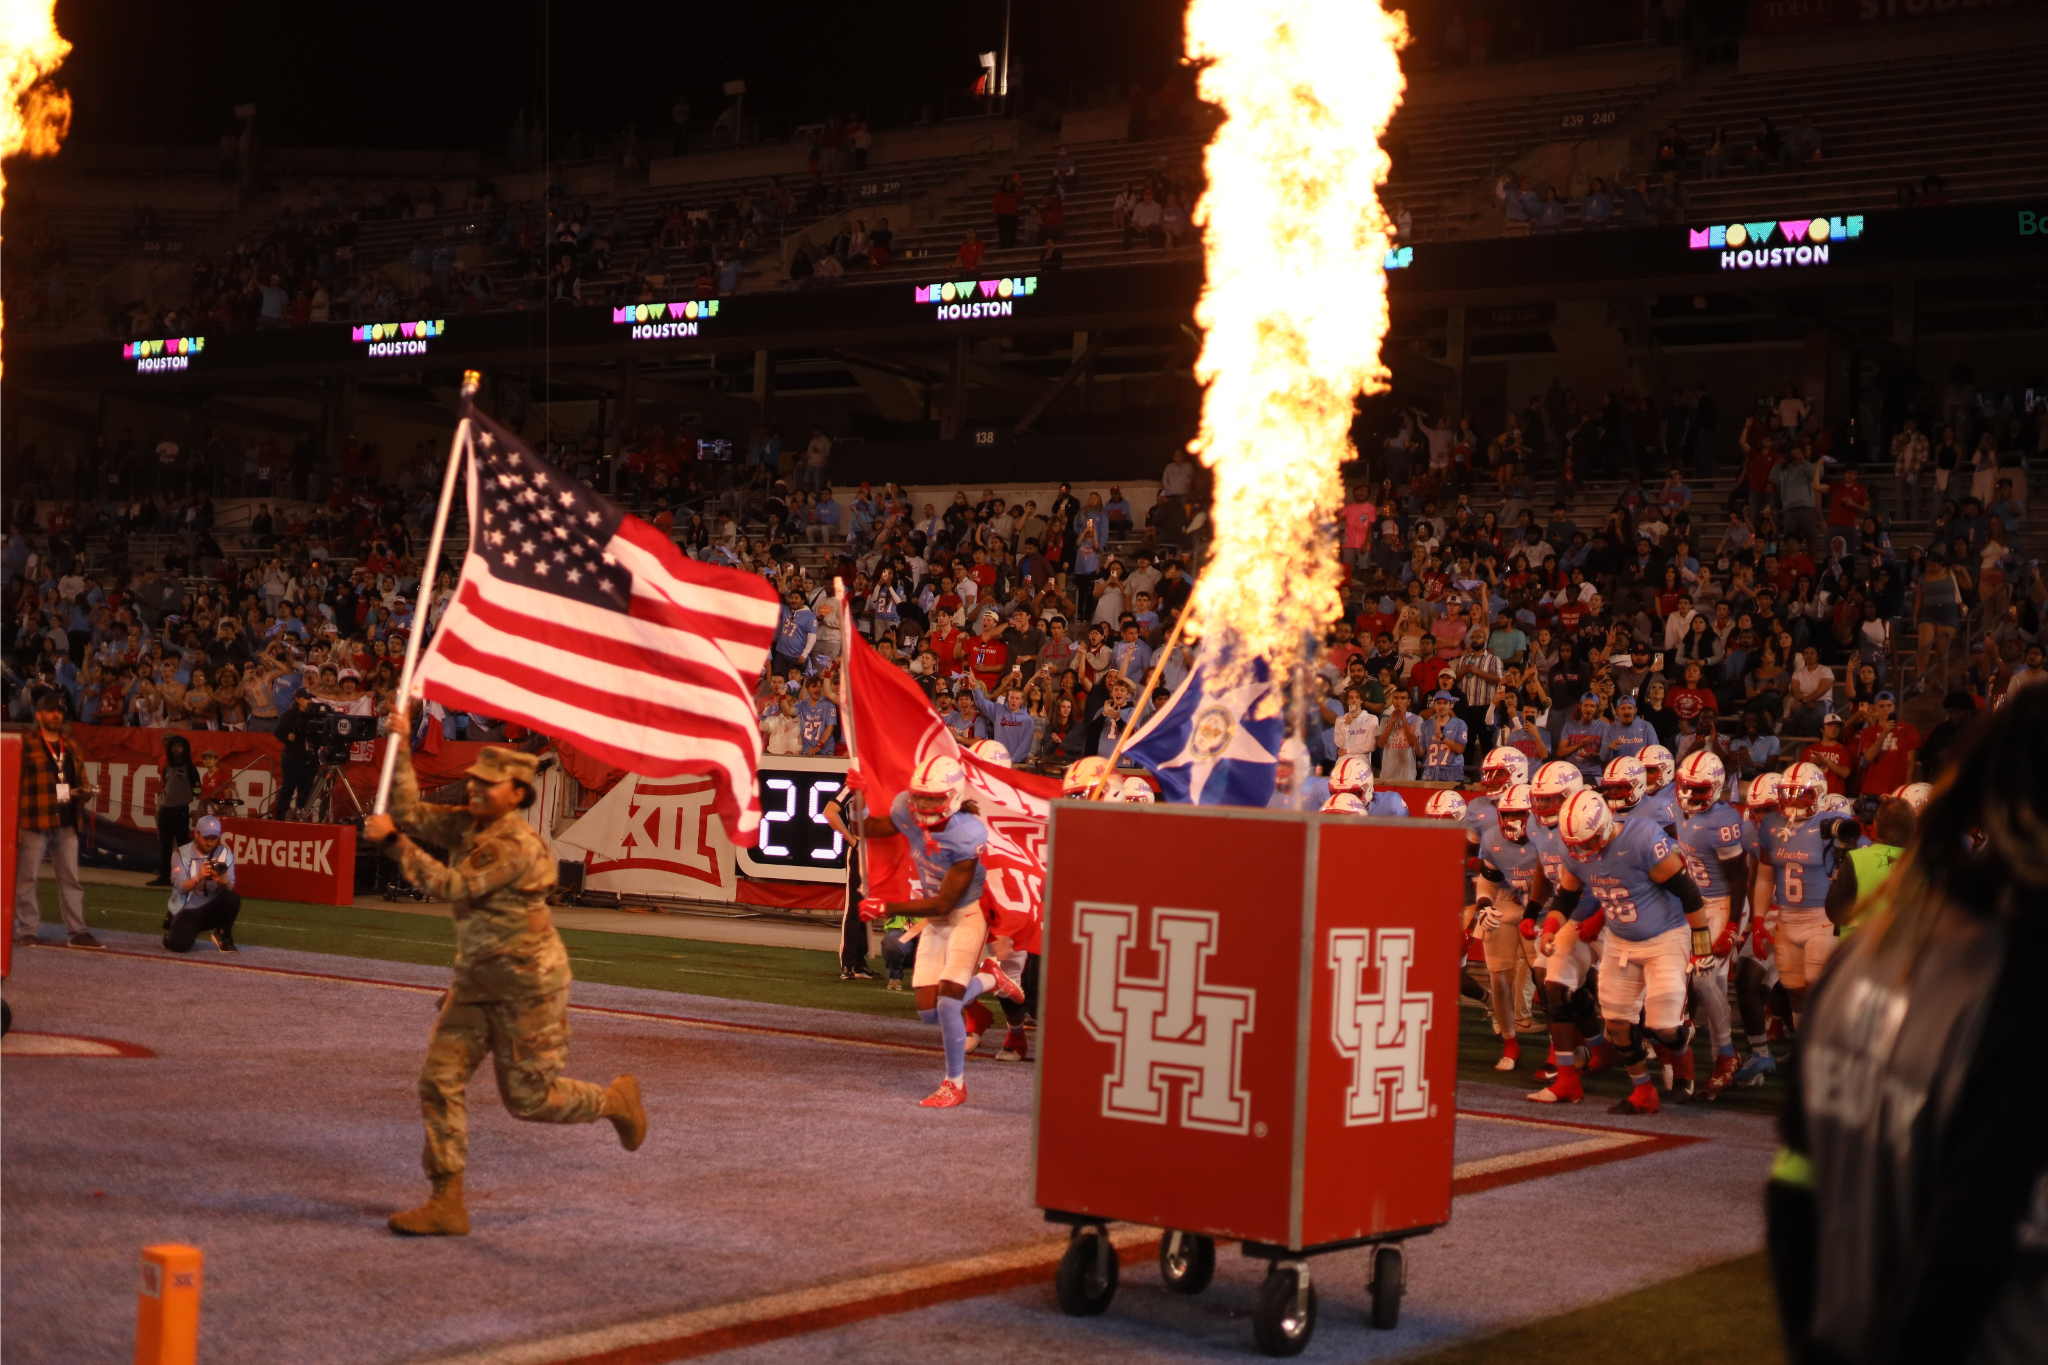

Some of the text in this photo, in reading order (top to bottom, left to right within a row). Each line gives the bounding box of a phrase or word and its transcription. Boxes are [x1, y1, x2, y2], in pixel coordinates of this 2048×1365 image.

[1562, 111, 1616, 127] 239 240
[861, 184, 877, 195] 238
[1690, 215, 1863, 249] MEOW WOLF
[1384, 246, 1413, 269] LF
[1722, 245, 1829, 269] HOUSTON
[915, 277, 1037, 303] MEOW WOLF
[613, 300, 719, 323] MEOW WOLF
[938, 301, 1012, 320] HOUSTON
[352, 319, 444, 342] MEOW WOLF
[632, 322, 698, 339] HOUSTON
[123, 337, 204, 358] MEOW WOLF
[369, 341, 426, 356] HOUSTON
[138, 356, 188, 371] HOUSTON
[975, 431, 994, 443] 138
[259, 467, 269, 476] 137
[782, 618, 797, 637] 27
[803, 721, 821, 741] 27
[1428, 744, 1450, 766] 27
[759, 778, 843, 860] 25
[1719, 822, 1742, 843] 88
[220, 832, 334, 875] SEATGEEK
[1776, 848, 1809, 860] Houston
[1589, 874, 1621, 885] Houston
[1784, 861, 1804, 904] 6
[1590, 886, 1638, 923] 66
[1072, 901, 1256, 1136] UH
[1328, 928, 1433, 1127] UH
